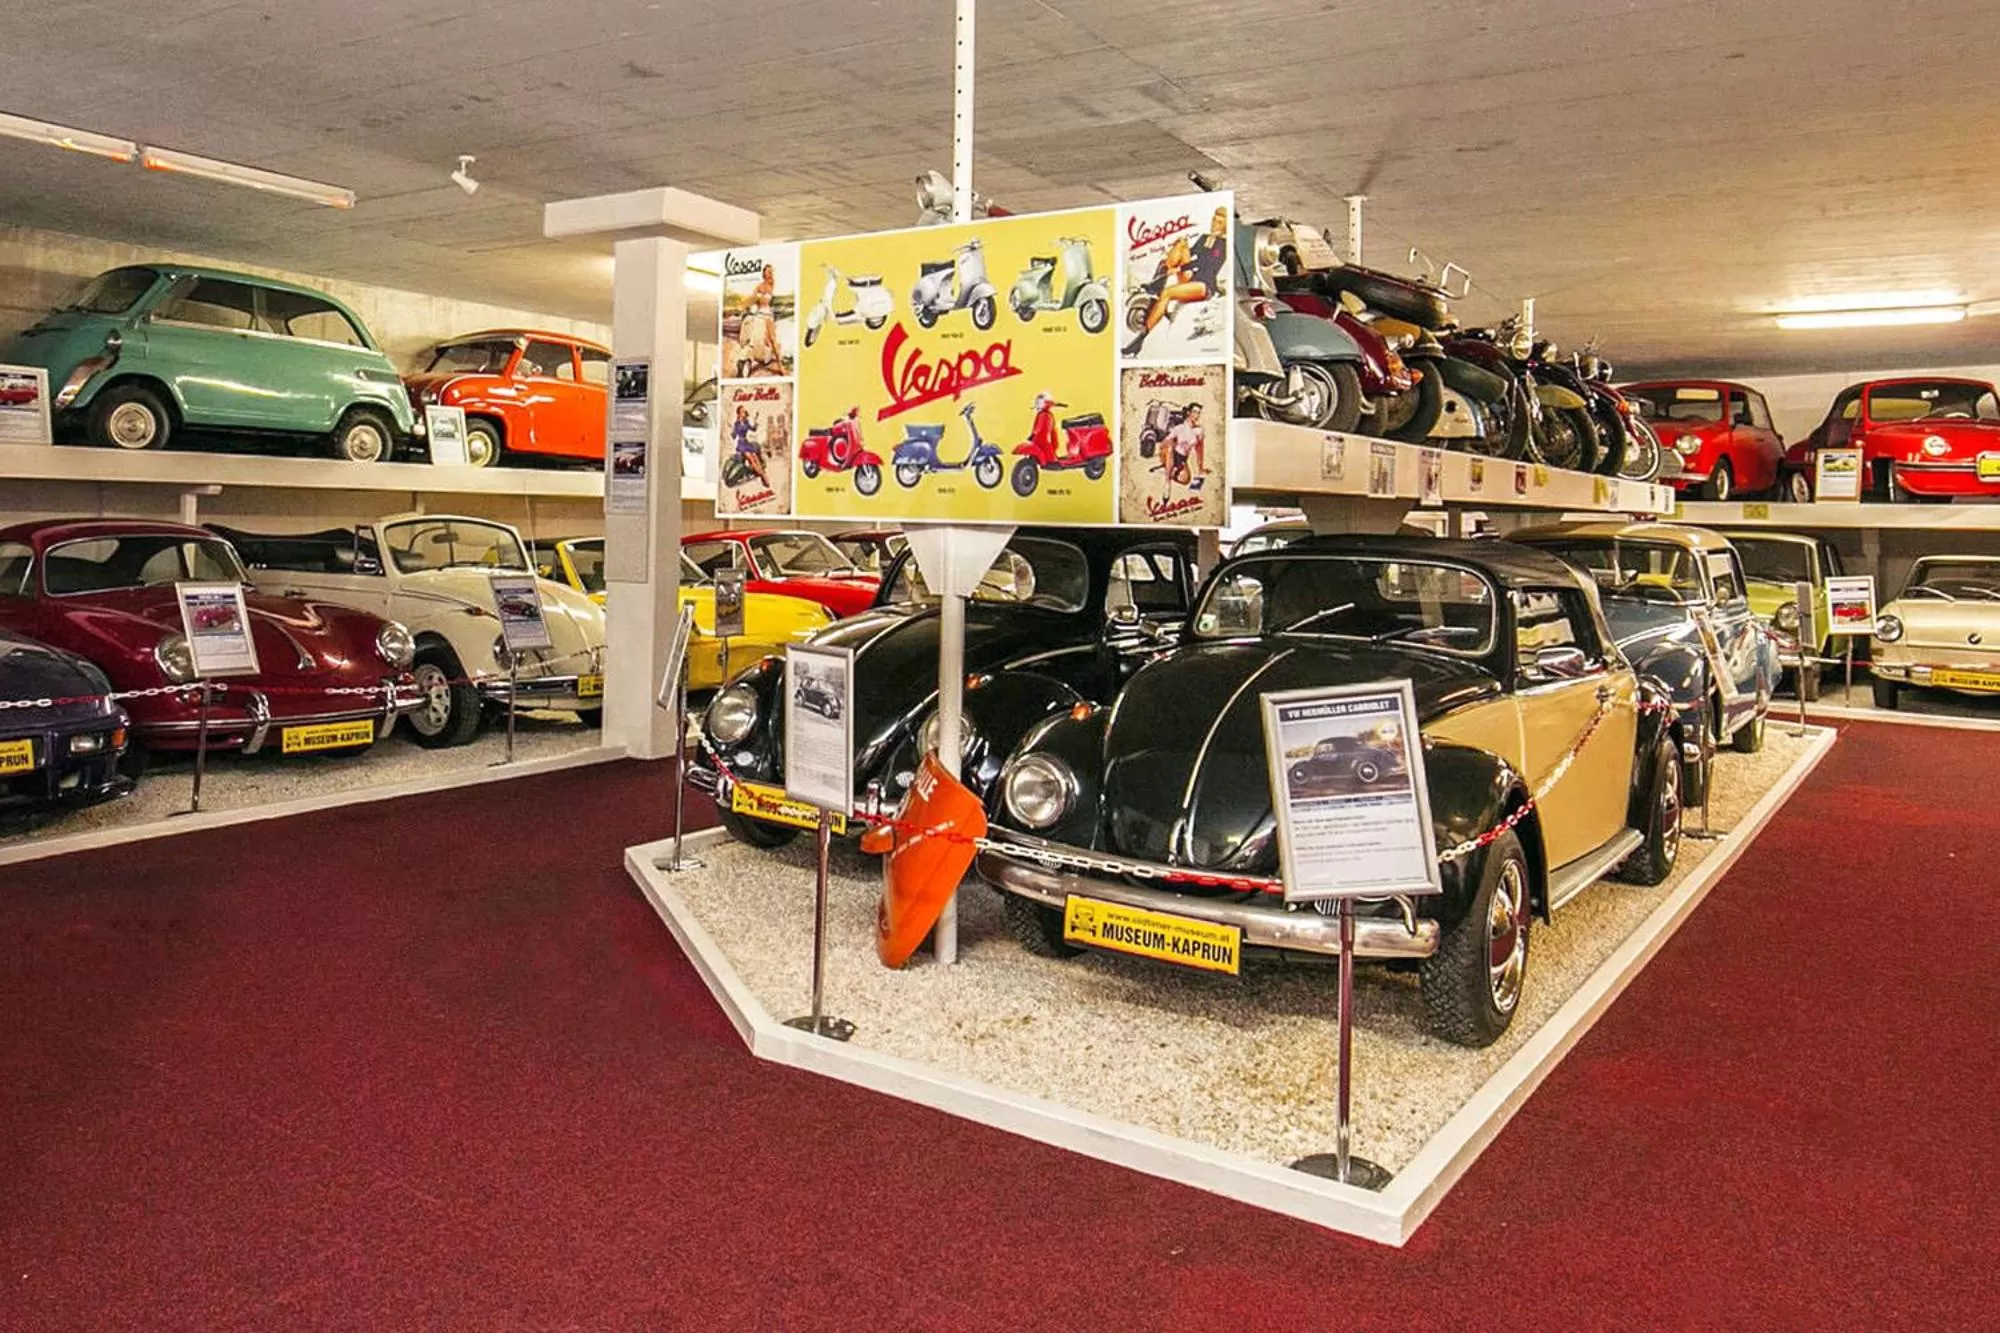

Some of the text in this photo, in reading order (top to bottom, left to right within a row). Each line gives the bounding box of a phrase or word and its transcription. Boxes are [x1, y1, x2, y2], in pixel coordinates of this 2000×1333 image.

[1128, 215, 1198, 250] Vespa
[724, 252, 762, 277] Vespa
[877, 321, 1023, 422] Vespa
[1147, 495, 1204, 517] Vespa
[1101, 922, 1233, 965] MUSEUM-KAPRUN
[1107, 911, 1230, 943] www.oldtimer-museum.at
